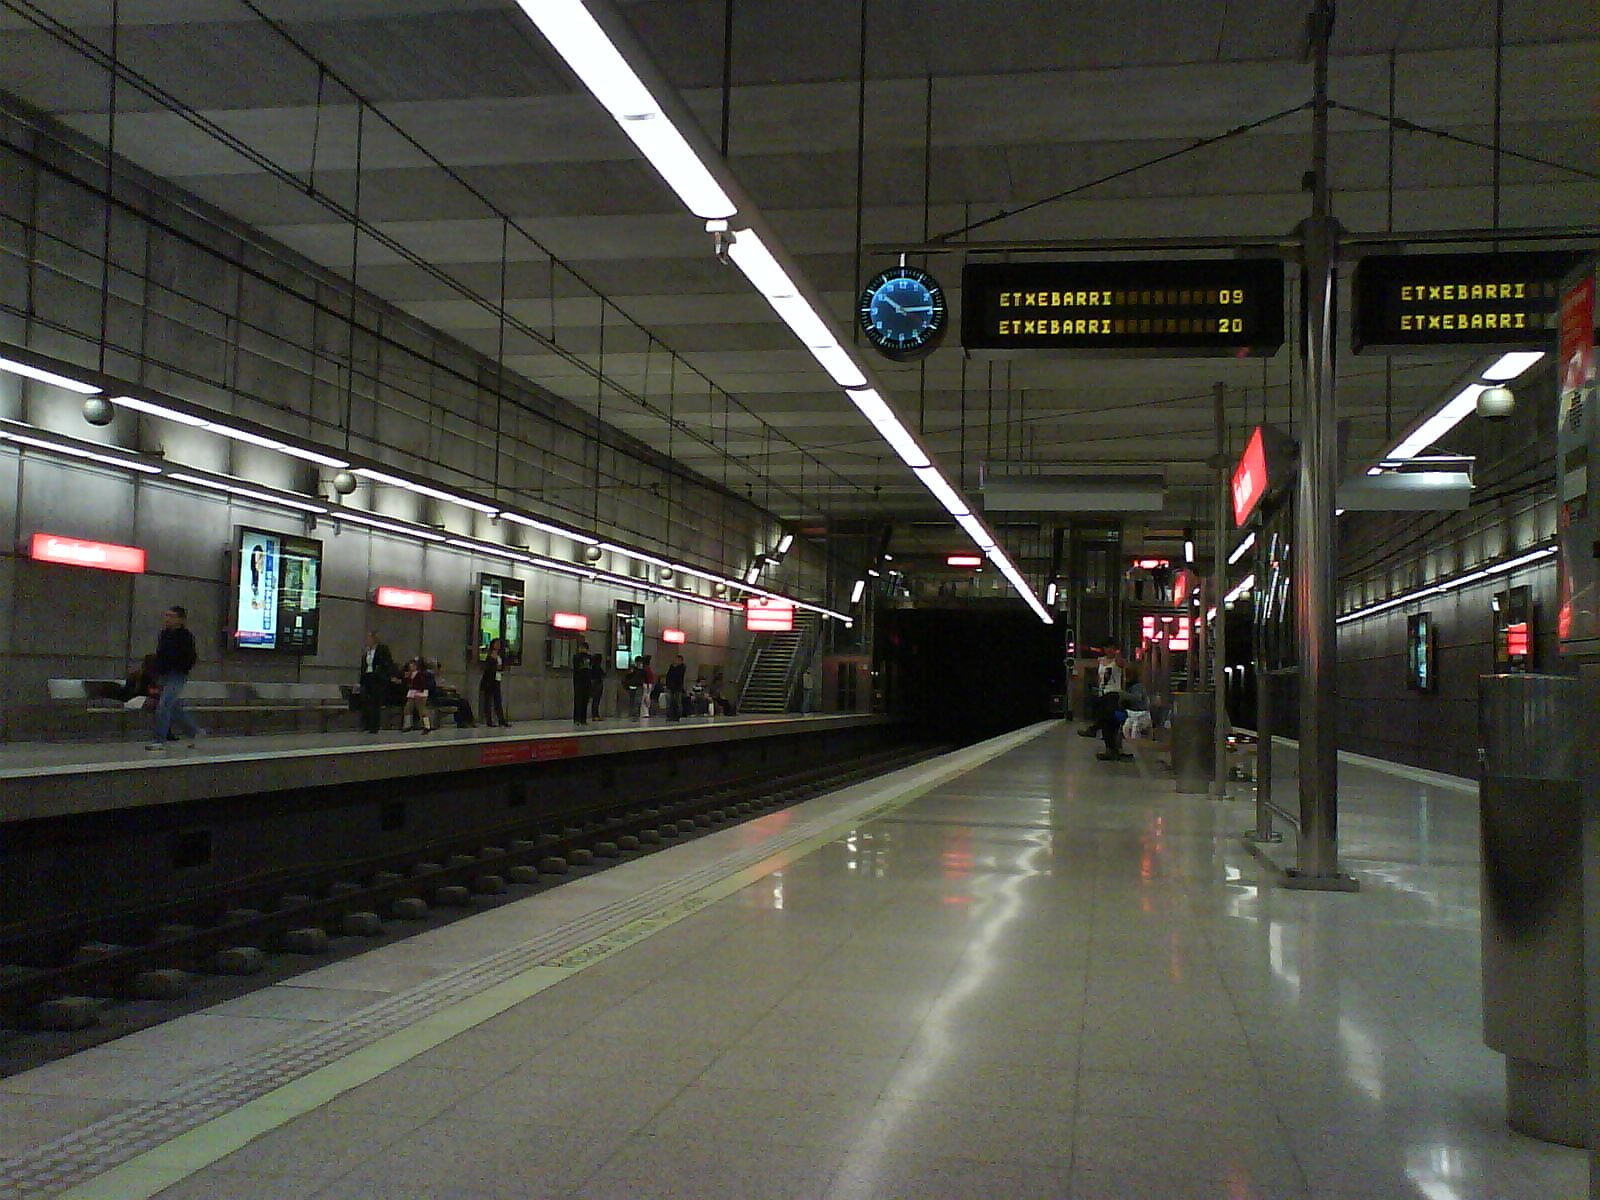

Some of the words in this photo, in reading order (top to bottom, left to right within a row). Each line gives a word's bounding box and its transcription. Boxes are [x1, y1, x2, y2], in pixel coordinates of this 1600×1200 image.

[1000, 291, 1112, 307] ETXEBARRI
[1219, 289, 1243, 305] 09
[1401, 283, 1525, 300] ETXEBARRI
[999, 319, 1111, 335] ETXEBARRI
[1218, 318, 1243, 333] 20
[1401, 313, 1525, 330] ETXEBARRI
